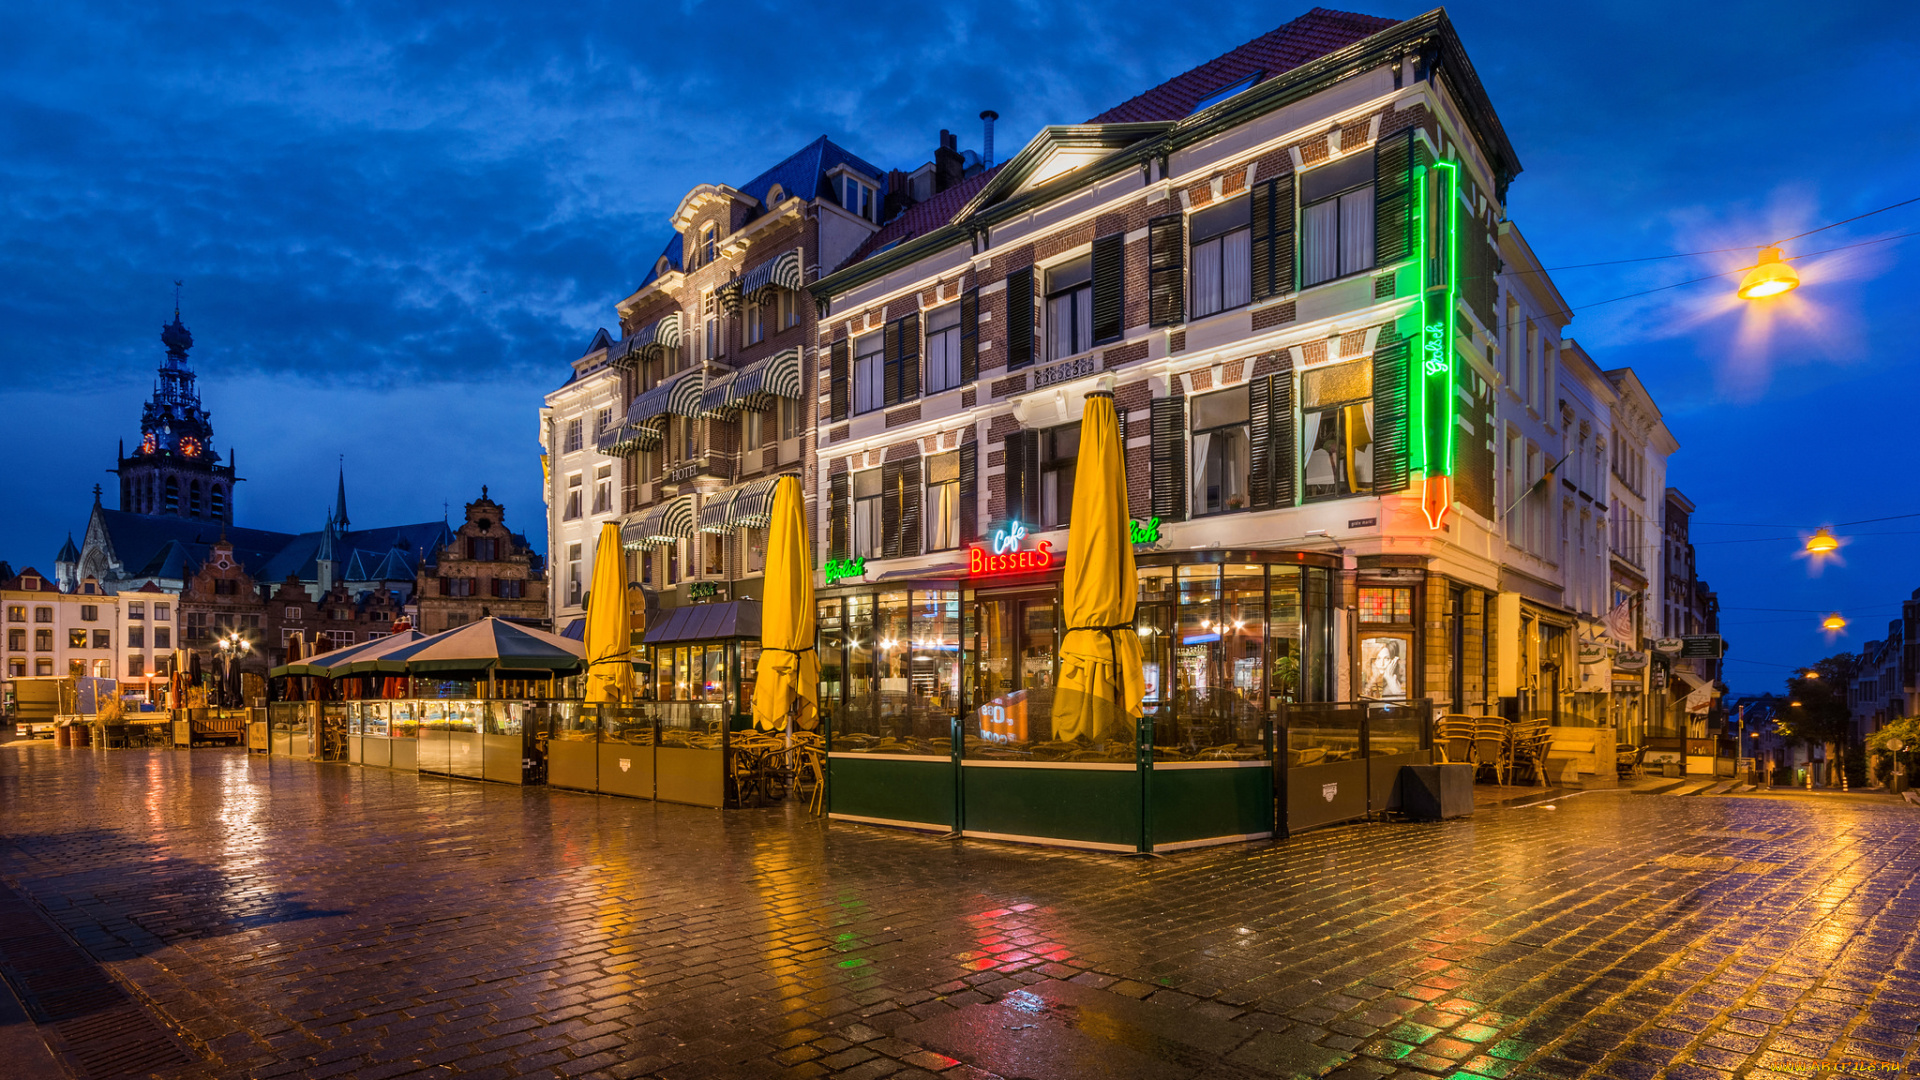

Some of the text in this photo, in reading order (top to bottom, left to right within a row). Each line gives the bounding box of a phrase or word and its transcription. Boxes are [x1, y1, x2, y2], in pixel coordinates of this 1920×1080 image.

[1425, 321, 1448, 376] Grolsch
[672, 464, 699, 482] HOTEL
[824, 557, 864, 584] Grolsch
[971, 540, 1053, 573] BIESSELS
